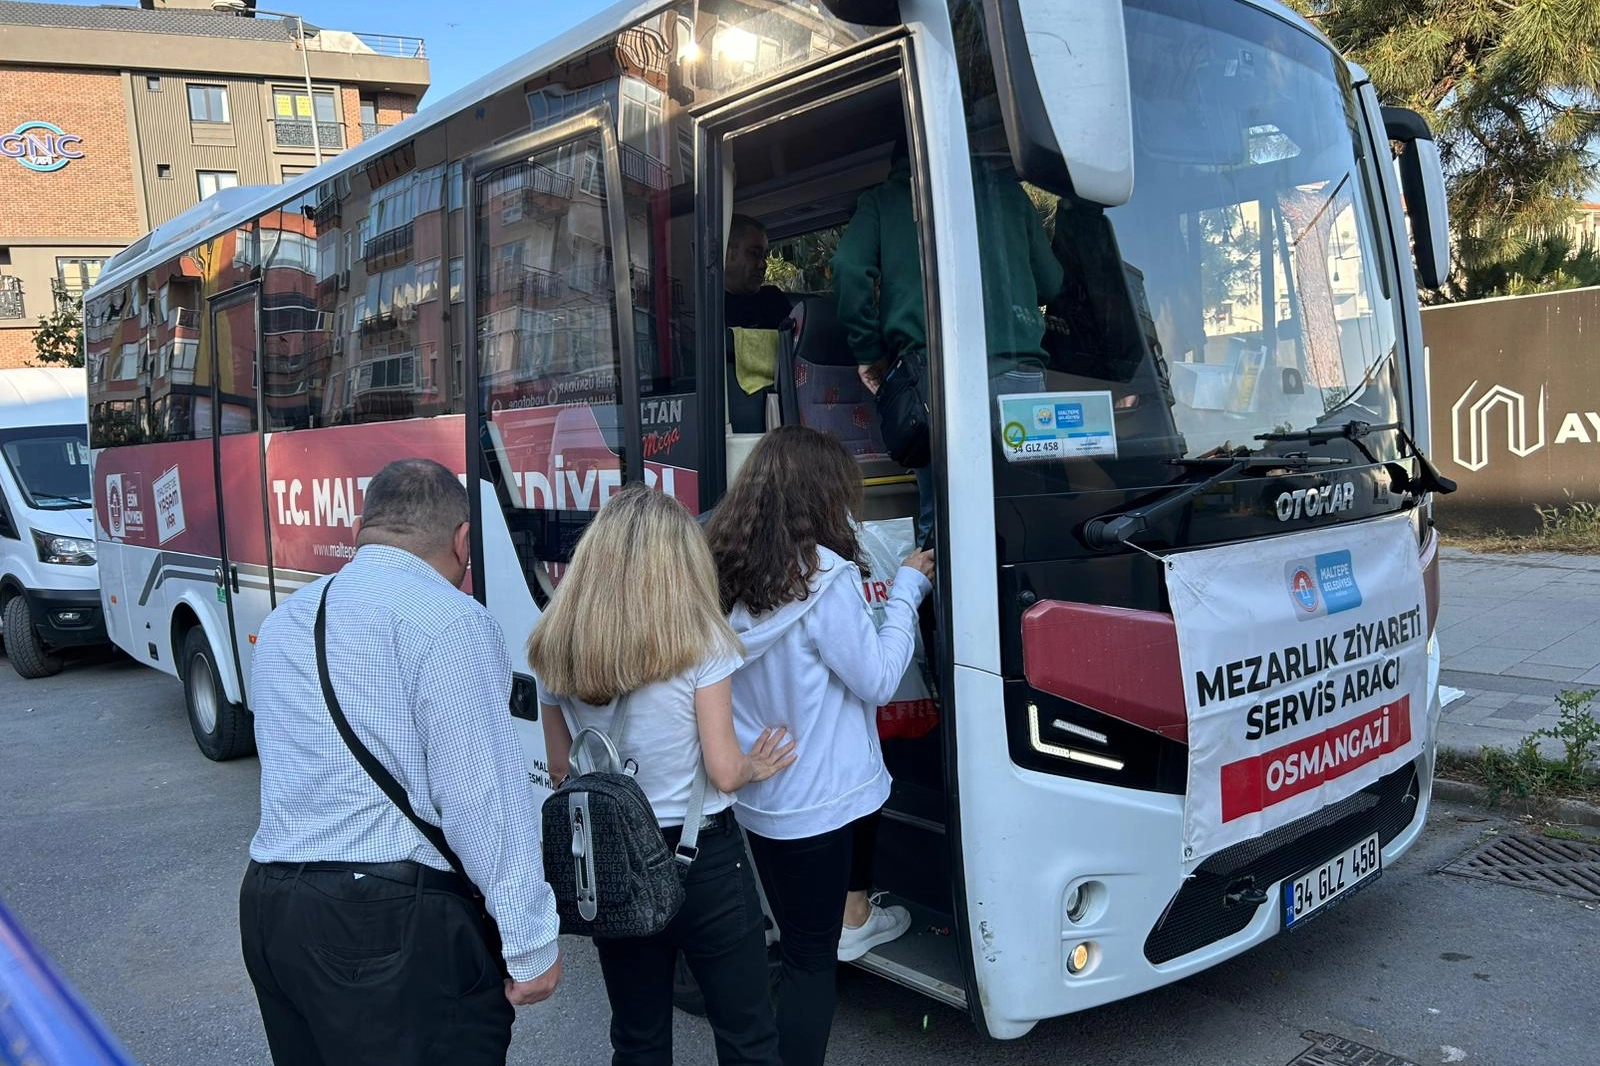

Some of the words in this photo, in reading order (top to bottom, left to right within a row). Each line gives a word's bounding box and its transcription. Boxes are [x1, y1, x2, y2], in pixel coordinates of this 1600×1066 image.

[0, 133, 84, 158] GNC
[640, 399, 682, 424] LTAN
[1026, 443, 1040, 453] GLZ
[1043, 442, 1058, 452] 458
[273, 479, 310, 526] T.C.
[1276, 481, 1355, 522] OTOKAR
[1320, 563, 1349, 581] MALTEPE
[1196, 634, 1338, 707] MEZARLIK
[1343, 604, 1422, 662] ZİYARETİ
[1245, 679, 1336, 740] SERVİS
[1341, 657, 1400, 708] ARACI
[1266, 707, 1390, 791] OSMANGAZİ
[528, 772, 543, 787] ESMİ
[1295, 878, 1313, 915] 34
[1318, 857, 1344, 900] GLZ
[1352, 838, 1376, 877] 458
[1286, 905, 1294, 916] TR
